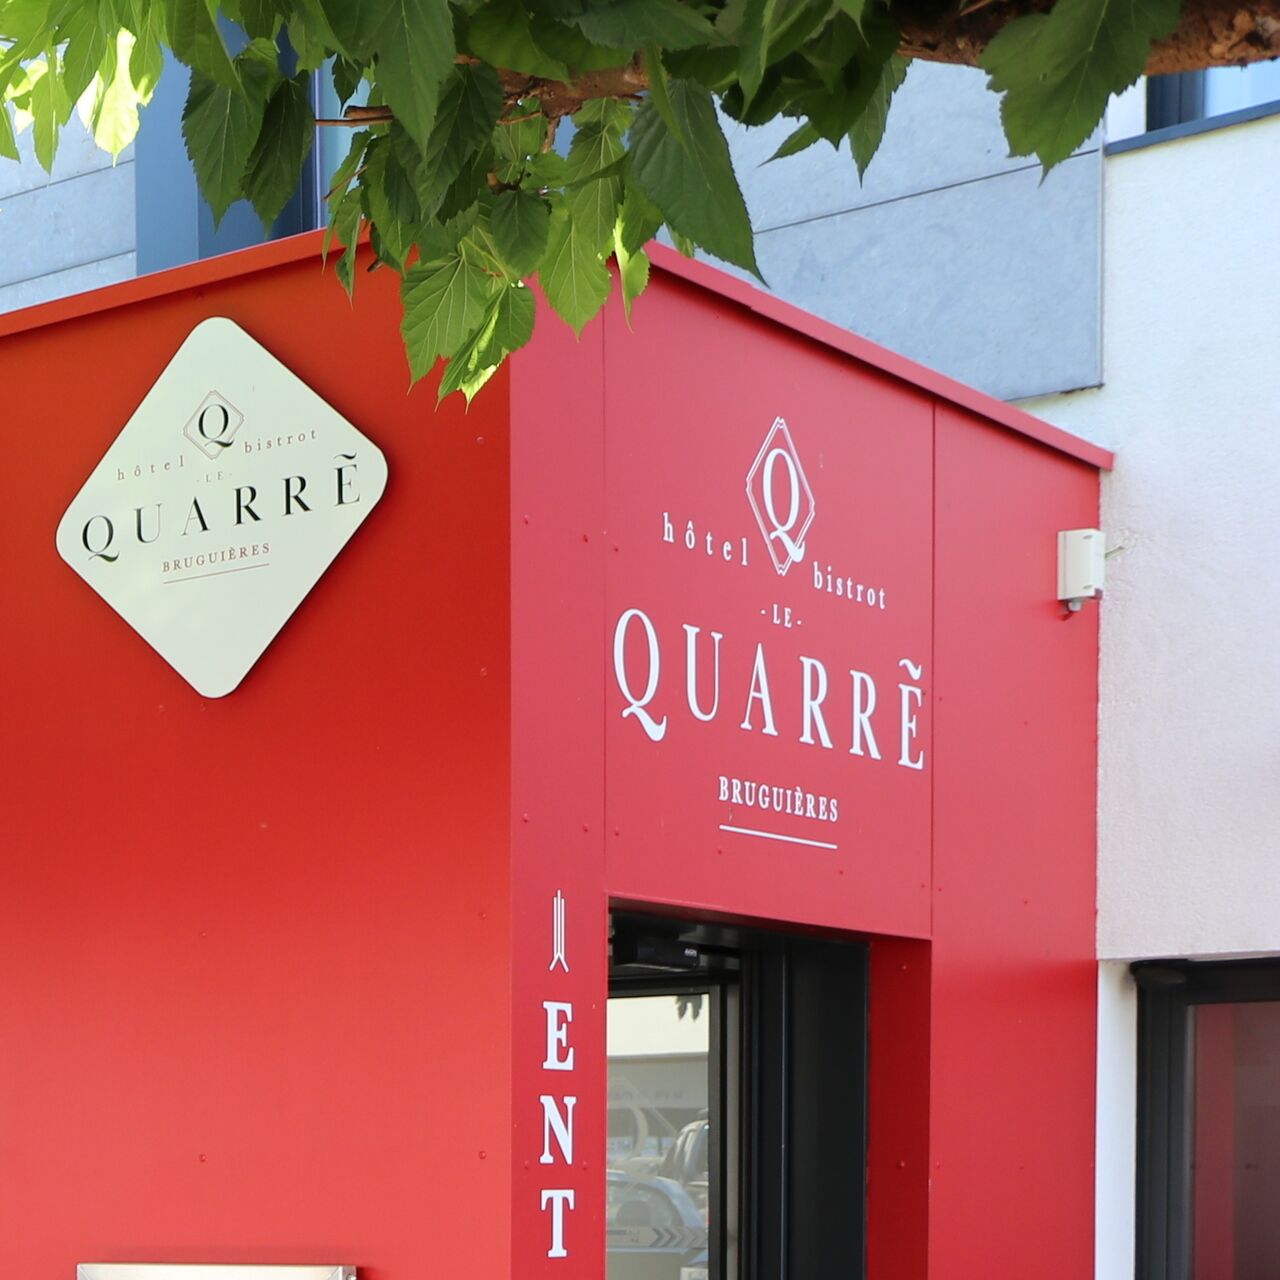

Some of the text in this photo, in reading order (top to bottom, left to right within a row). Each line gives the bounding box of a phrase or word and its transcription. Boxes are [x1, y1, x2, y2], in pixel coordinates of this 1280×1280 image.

[198, 403, 235, 448] Q
[117, 429, 318, 481] hôtel bistrot
[762, 447, 806, 563] Q
[162, 542, 271, 573] BRUGUIÈRES
[662, 511, 886, 610] hôtel bistrot
[718, 775, 839, 823] BRUGUIÈRES
